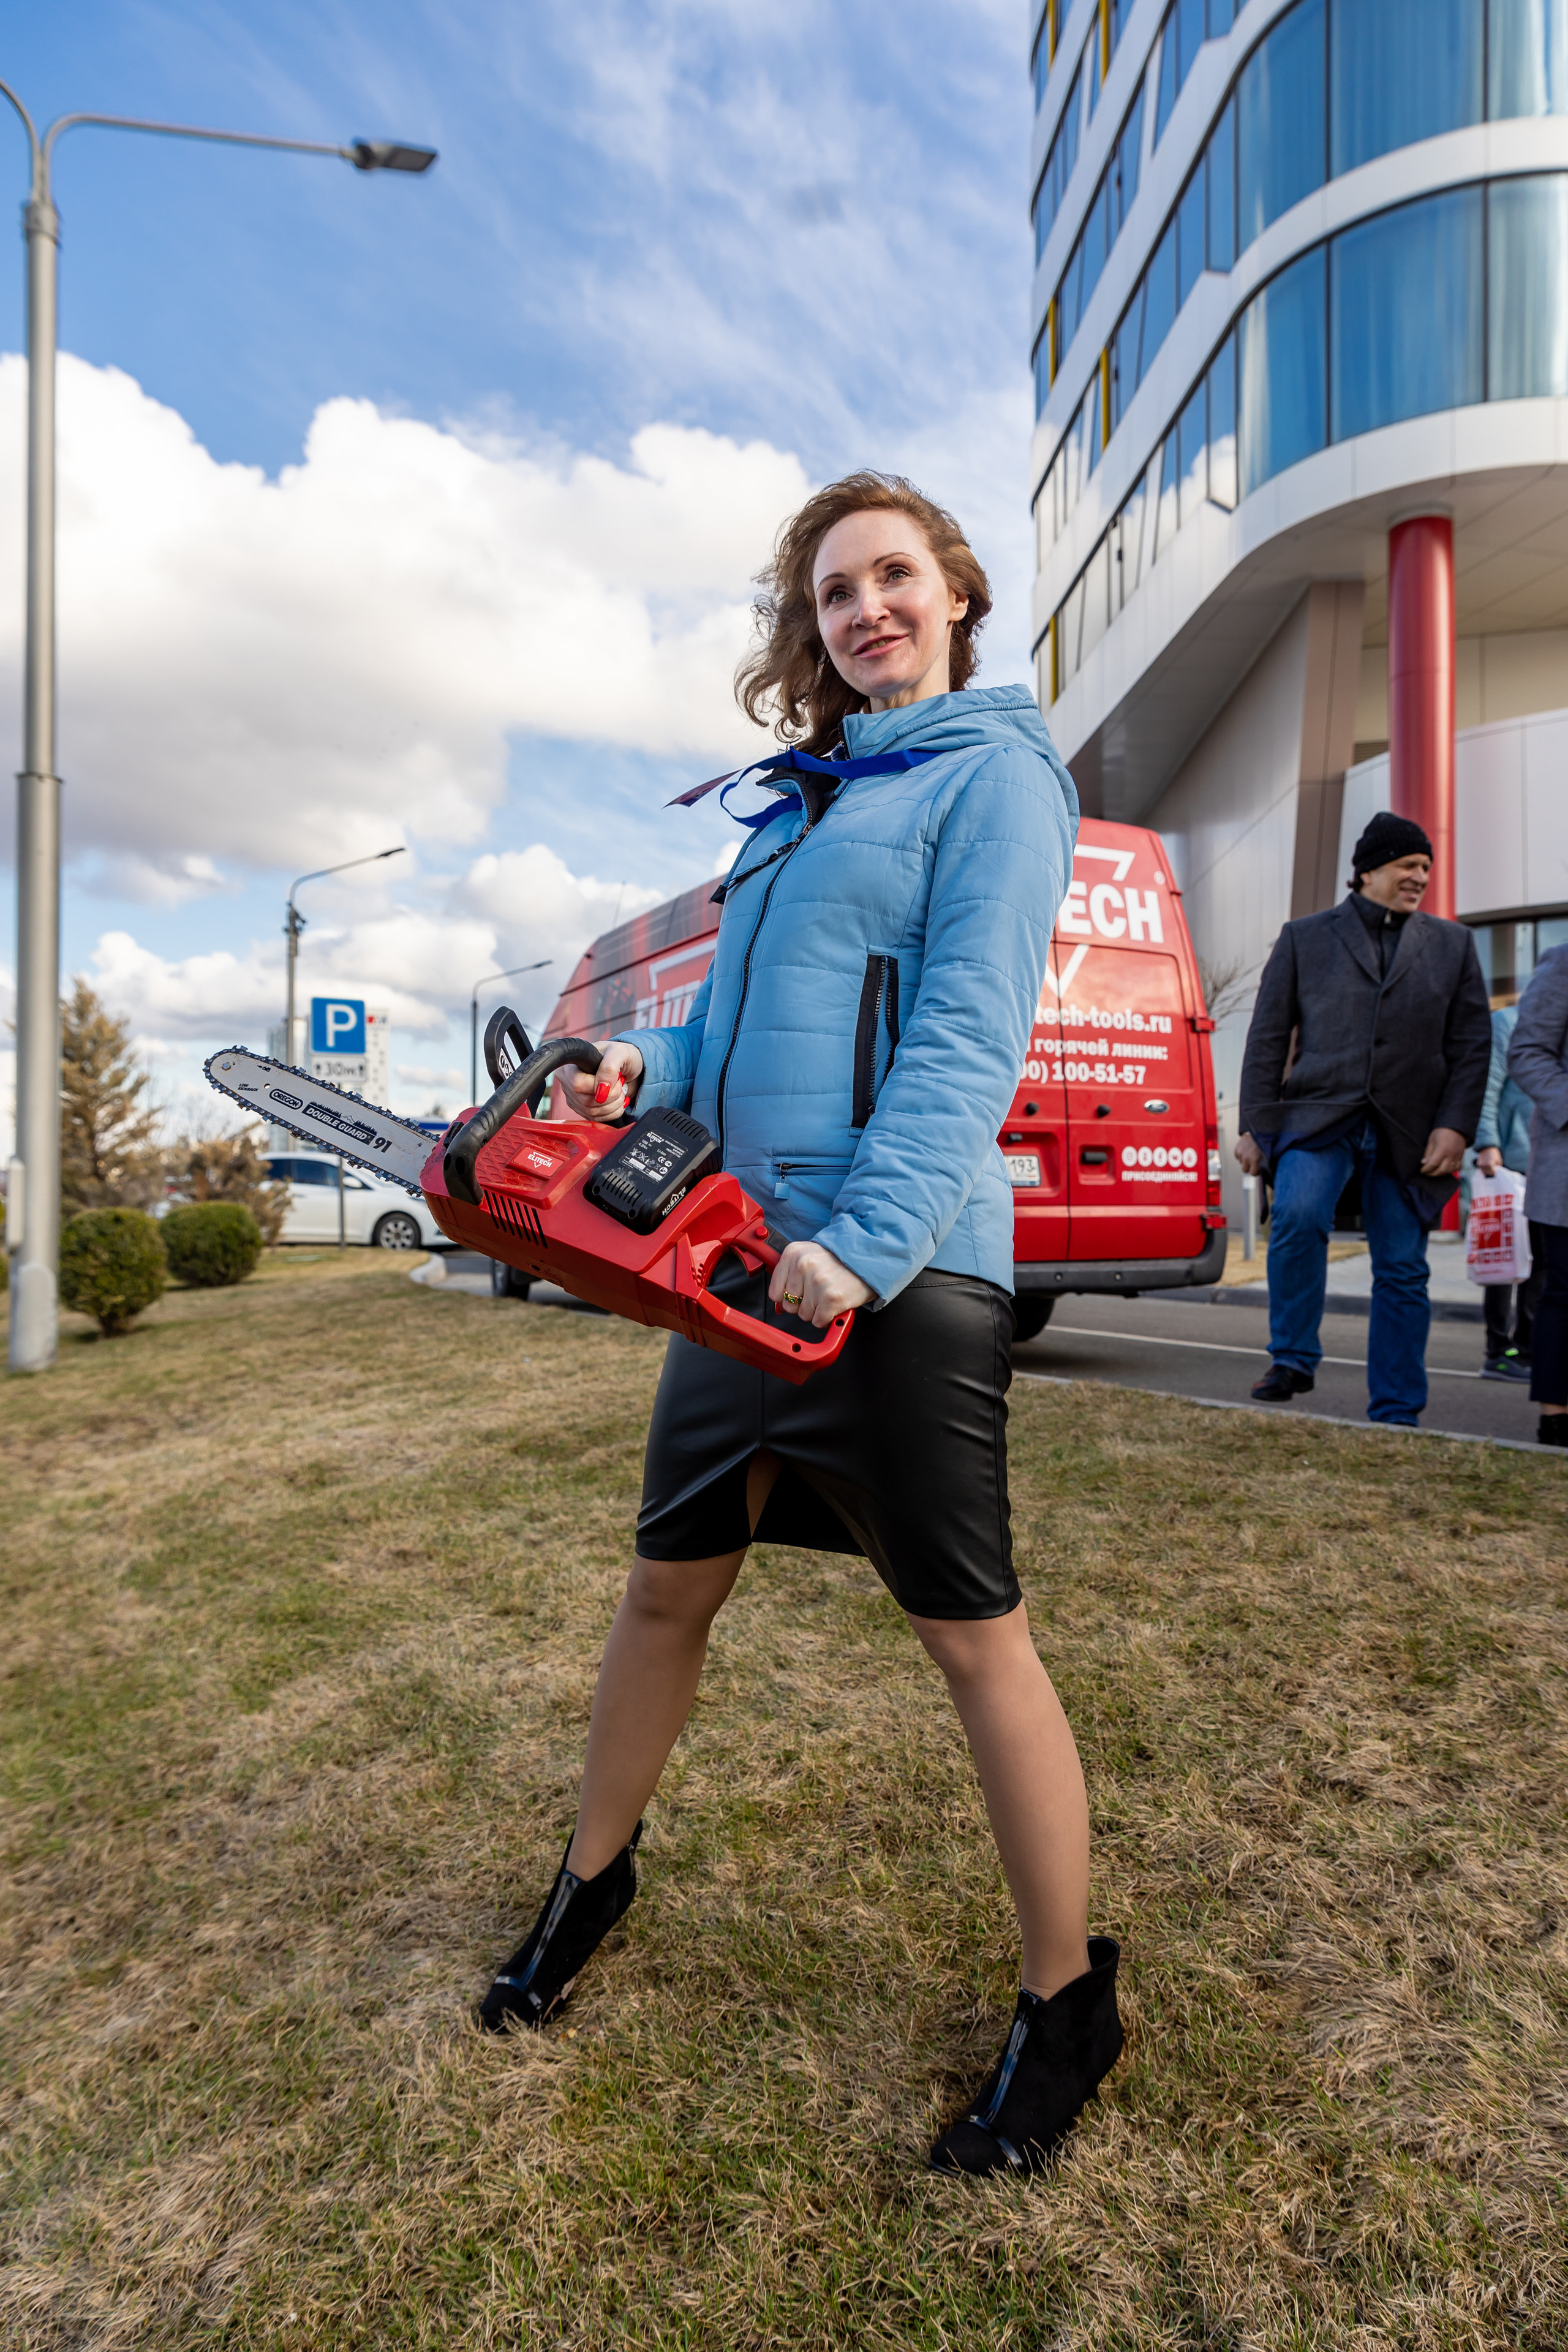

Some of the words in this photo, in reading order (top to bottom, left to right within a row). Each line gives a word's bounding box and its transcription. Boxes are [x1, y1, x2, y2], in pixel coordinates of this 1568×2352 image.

[326, 1003, 358, 1048] P
[1035, 1038, 1109, 1057] горячей
[1052, 1061, 1146, 1085] 100-51-57
[273, 1091, 300, 1107] OREGON
[306, 1107, 339, 1126] DOUBLE
[338, 1123, 368, 1140] GUARD
[372, 1137, 393, 1153] 91
[646, 1133, 662, 1144] ELITECH
[527, 1153, 552, 1167] ELITECH
